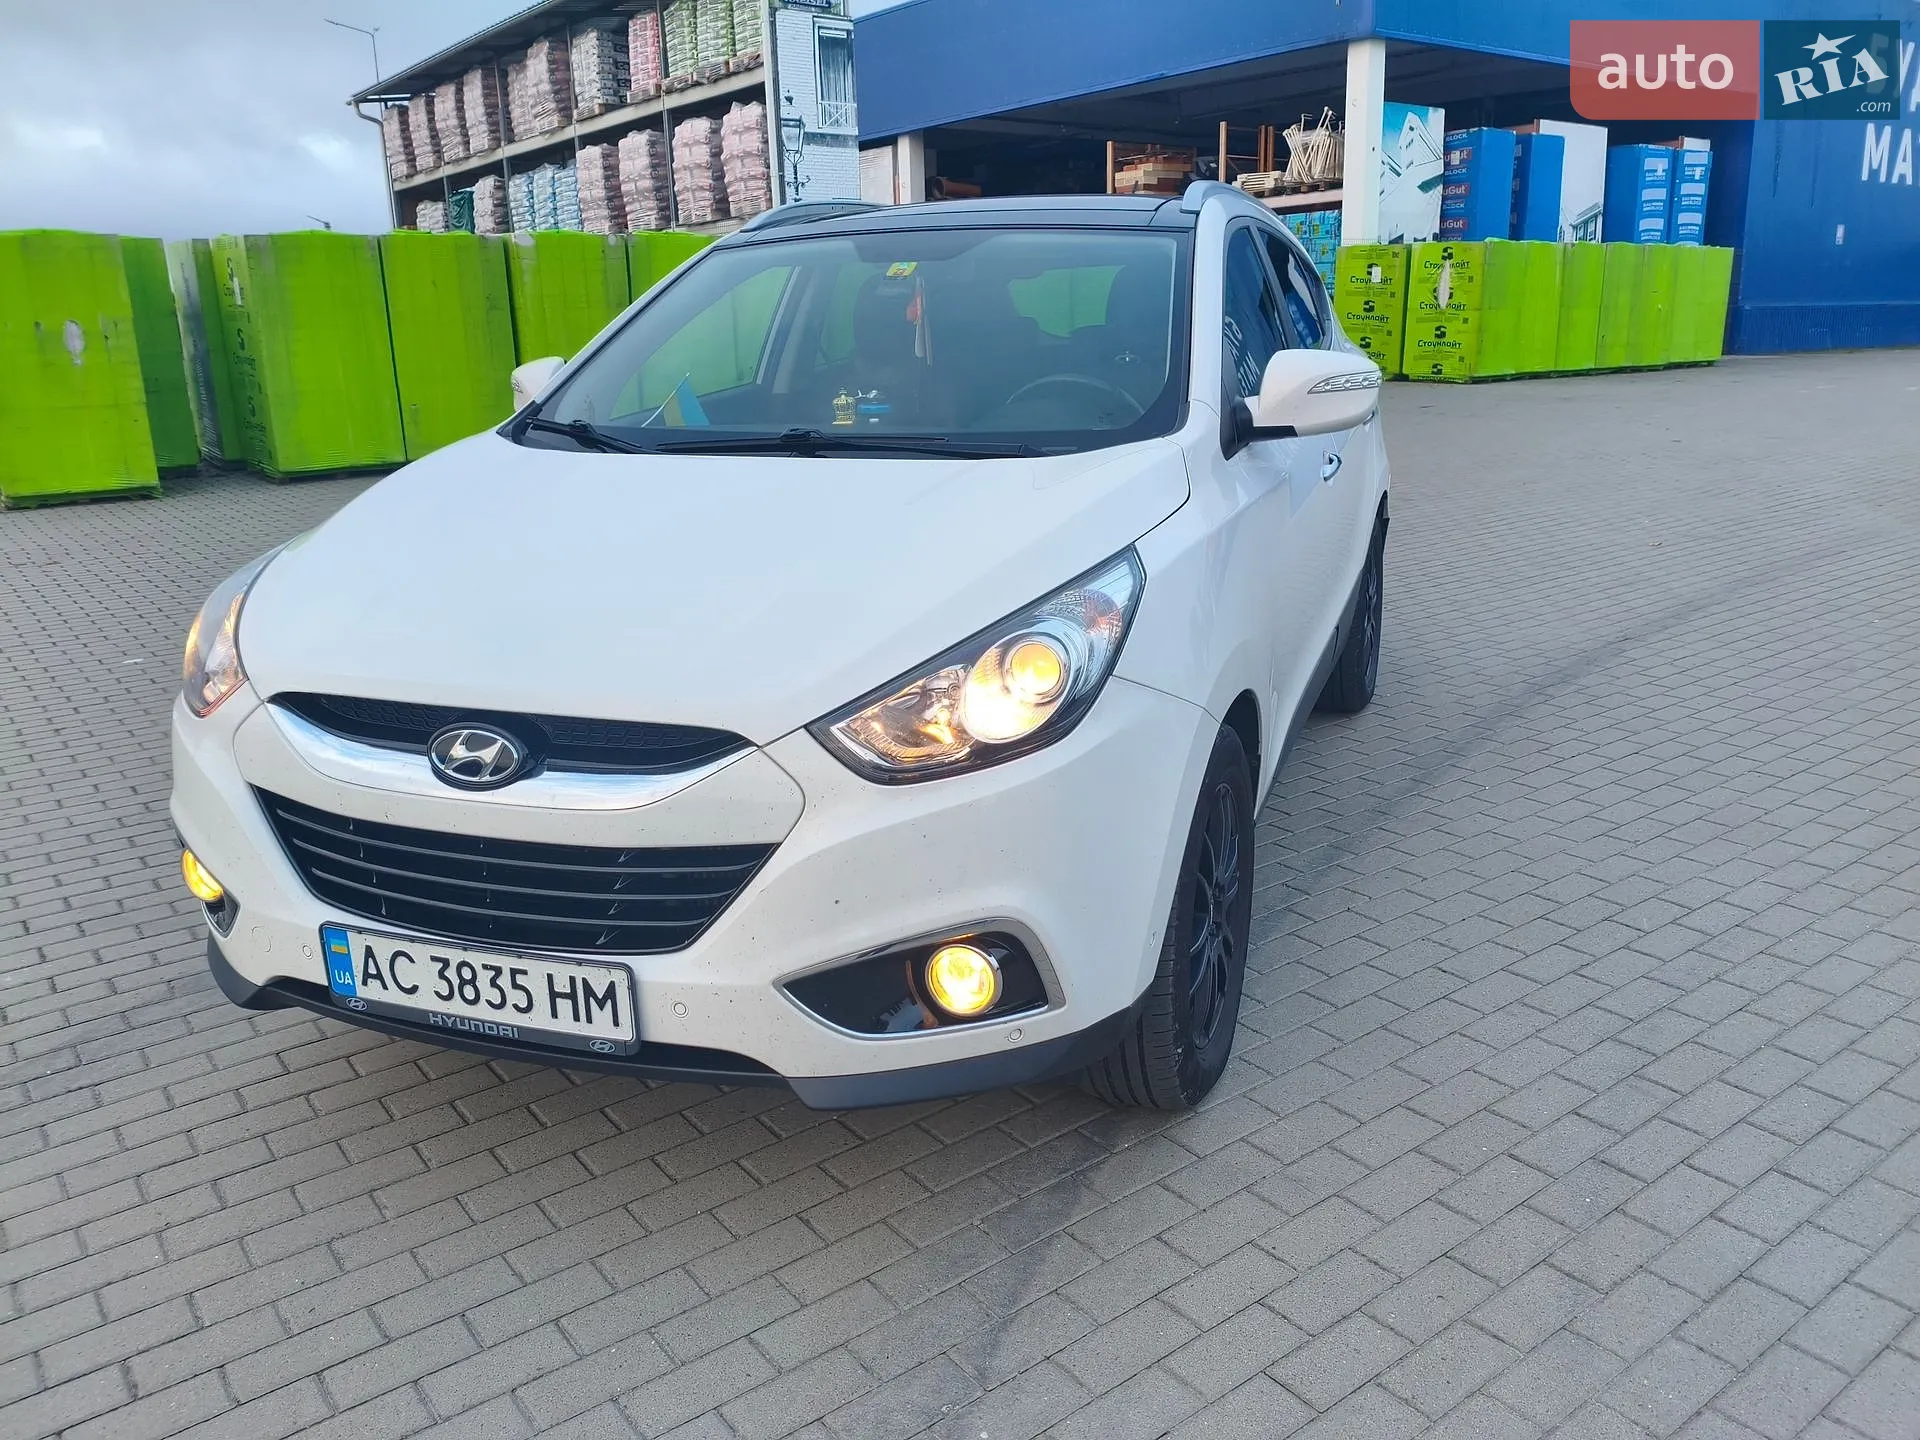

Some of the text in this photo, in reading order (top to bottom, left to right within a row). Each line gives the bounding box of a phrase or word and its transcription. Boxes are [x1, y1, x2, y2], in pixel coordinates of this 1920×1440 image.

[1861, 122, 1920, 186] МА
[335, 969, 354, 986] UA
[361, 944, 621, 1028] AC 3835 HM
[427, 1012, 520, 1039] HYUNDAI
